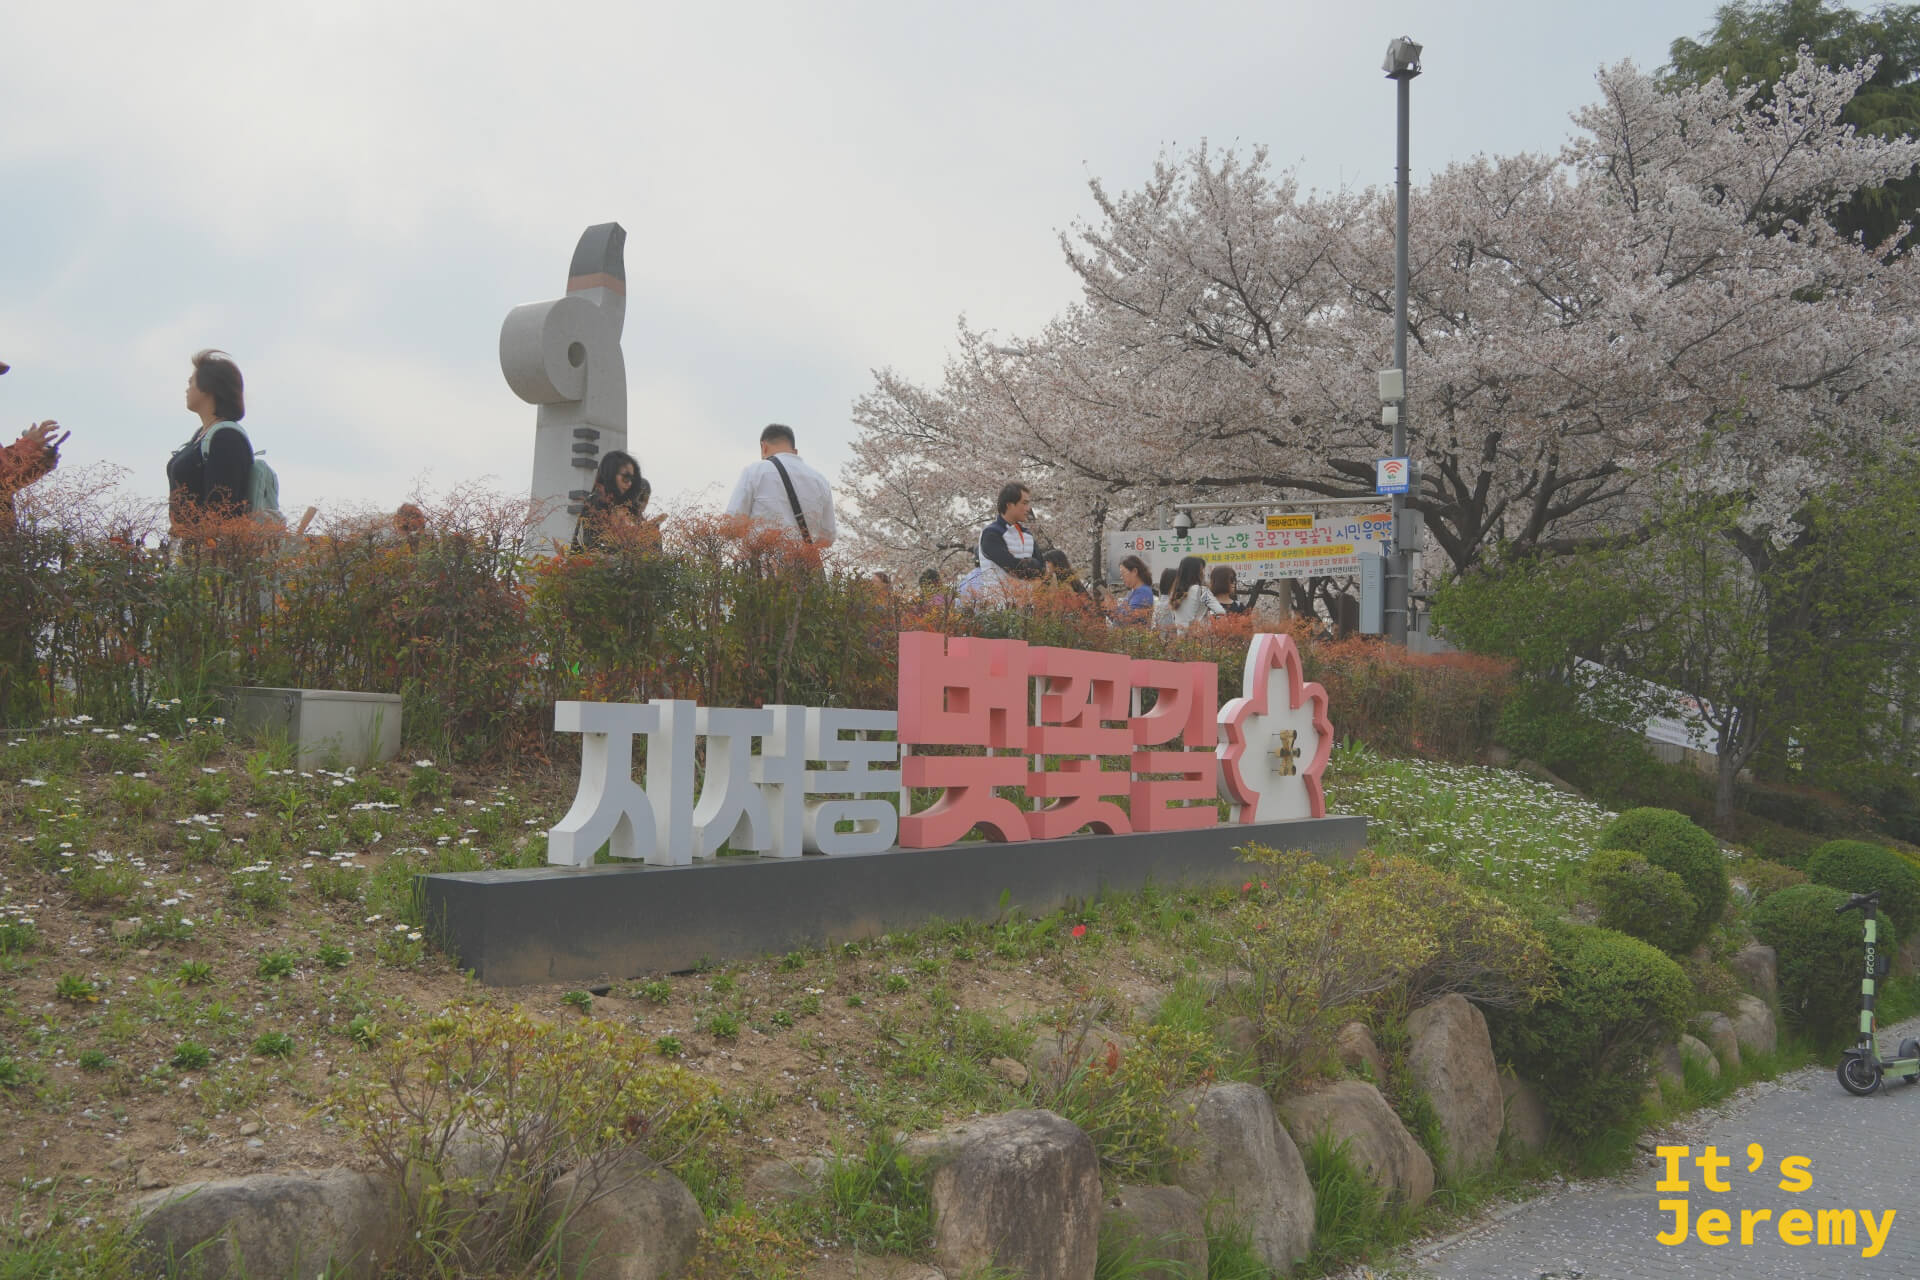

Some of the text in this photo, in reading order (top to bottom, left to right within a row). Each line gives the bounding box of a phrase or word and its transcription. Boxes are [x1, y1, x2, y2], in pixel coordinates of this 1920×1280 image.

[1124, 537, 1155, 551] 제8회
[1158, 535, 1194, 553] 능금꽃
[1198, 533, 1222, 551] 피는
[1224, 532, 1250, 549] 고향
[1254, 530, 1291, 549] 금호강
[1295, 527, 1333, 545] 벚꽃길
[548, 631, 1219, 867] 지저동 벚꽃길
